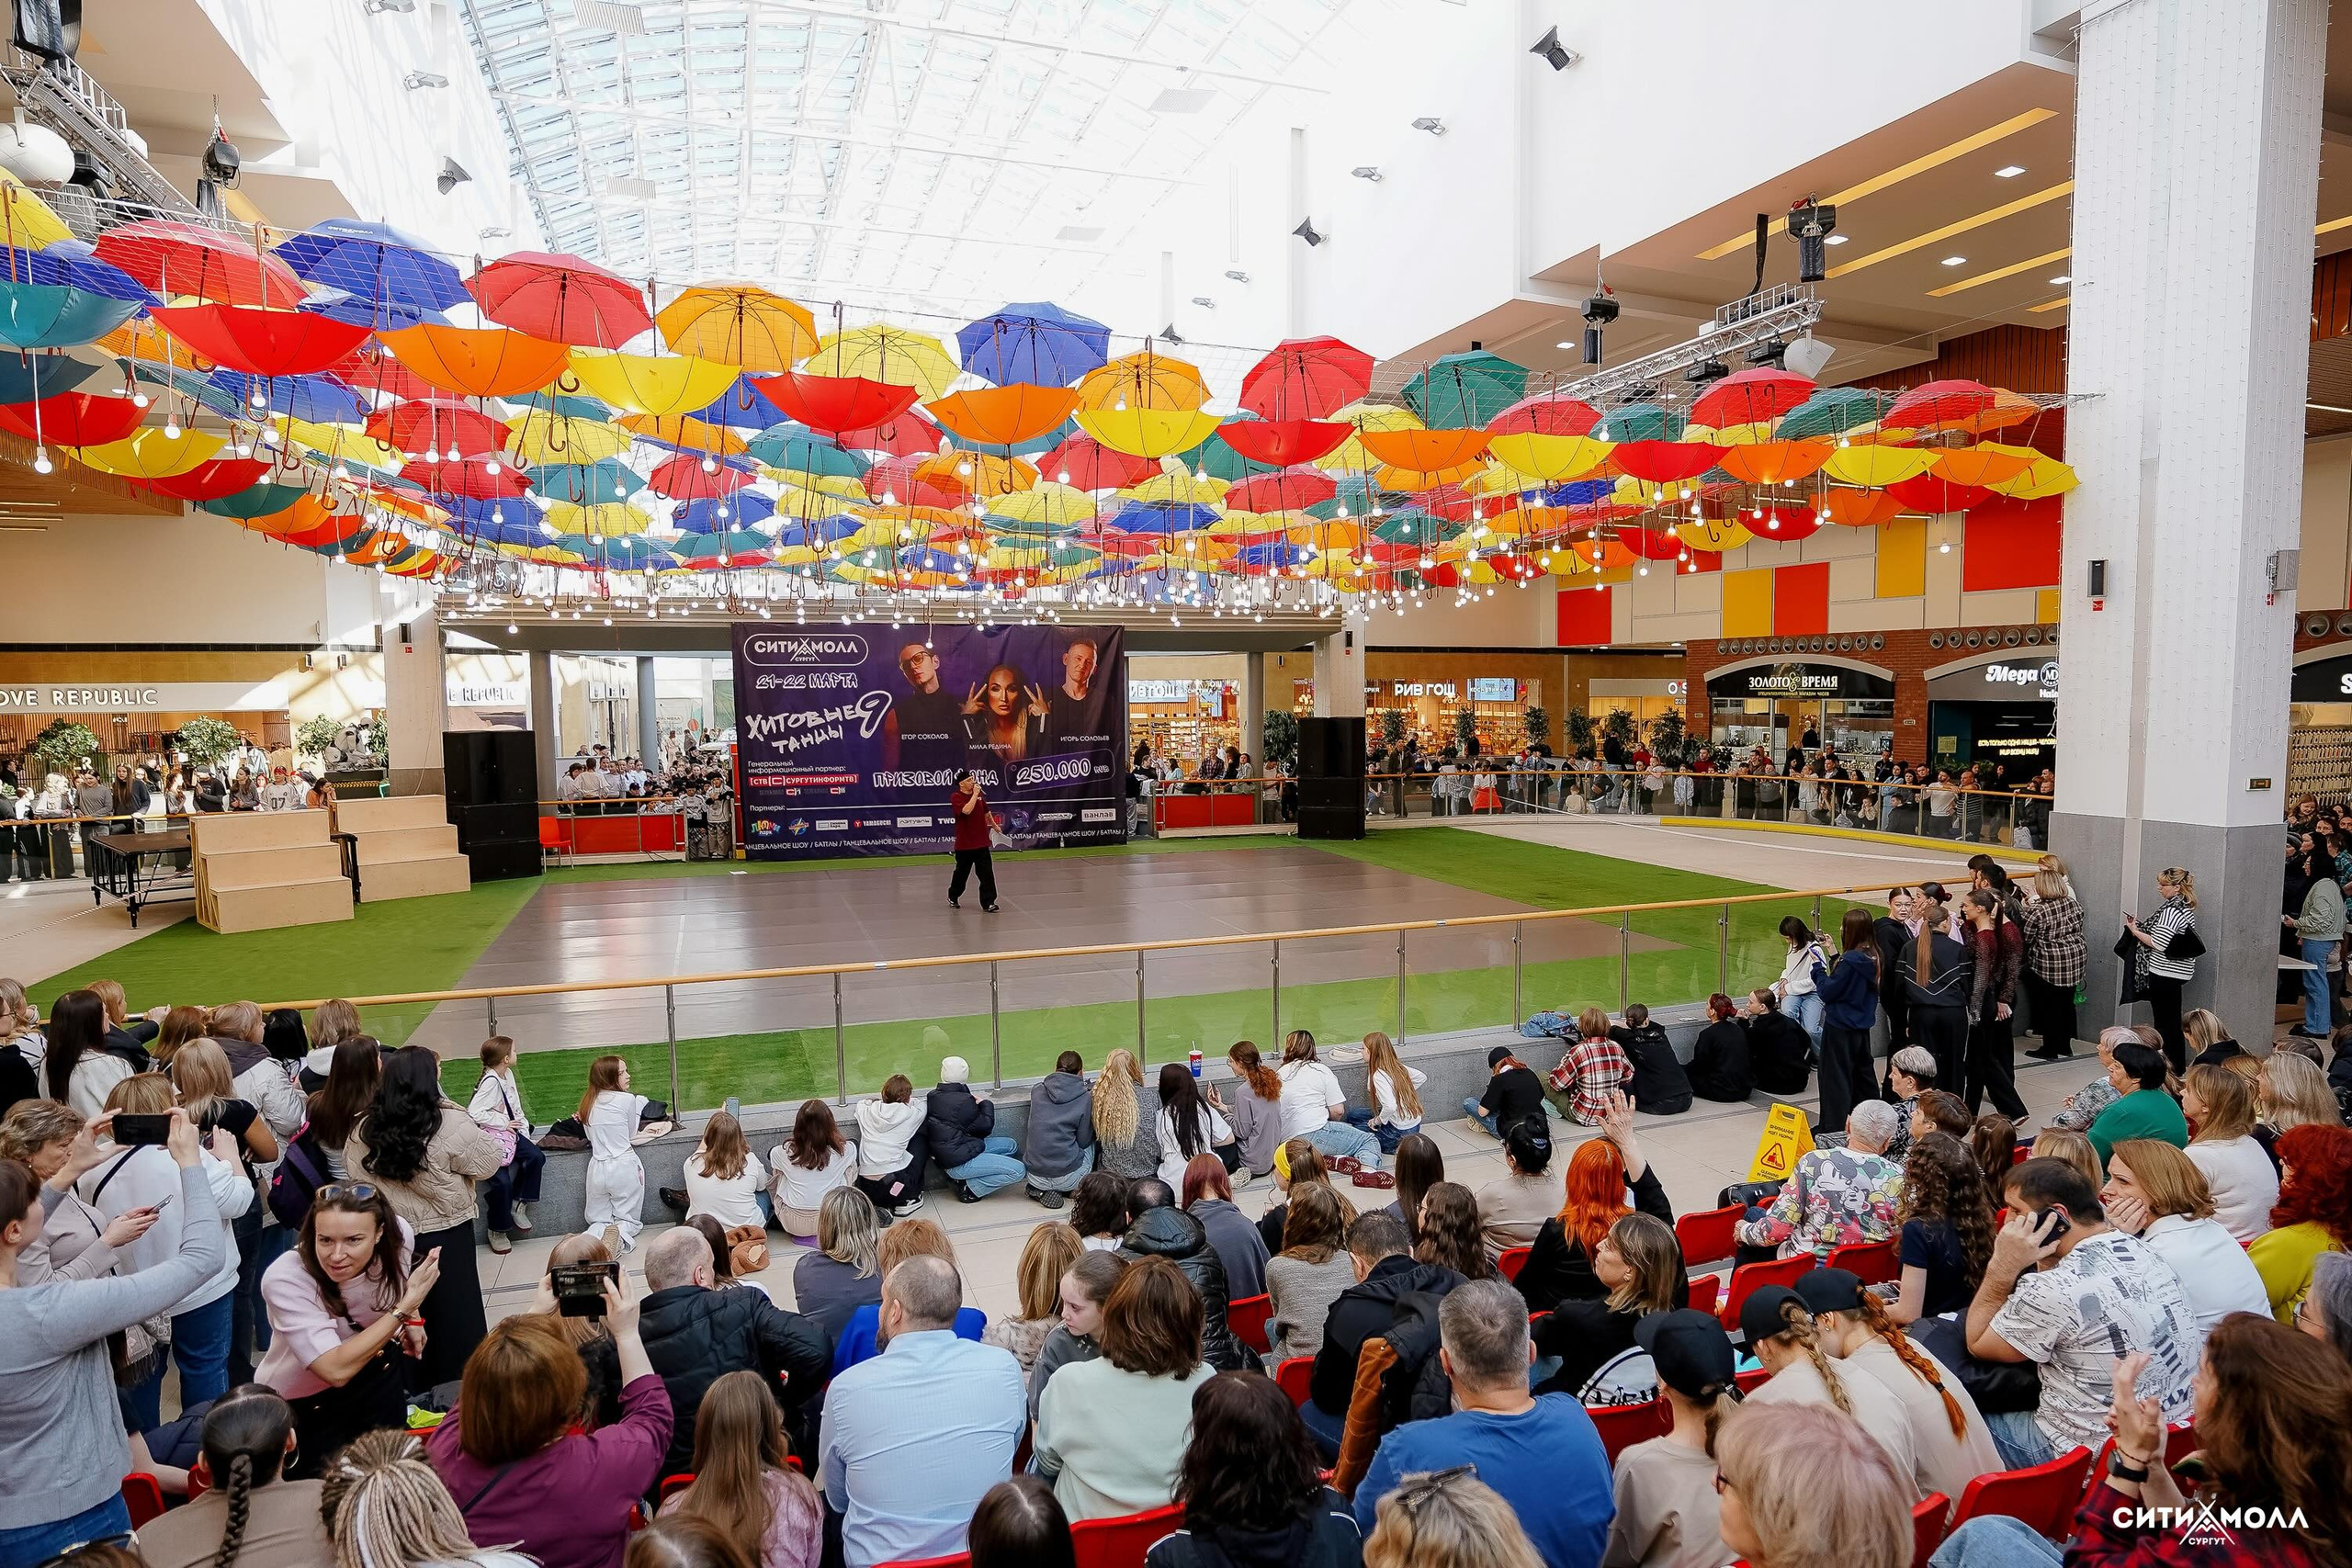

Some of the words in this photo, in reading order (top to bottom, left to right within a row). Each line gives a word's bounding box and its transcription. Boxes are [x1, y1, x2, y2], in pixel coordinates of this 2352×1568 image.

[754, 640, 797, 653] СИТИ
[811, 640, 858, 653] МОЛЛ
[755, 673, 807, 689] 21-22
[808, 672, 858, 689] МАРТА
[1748, 676, 1790, 688] ЗОЛОТО
[1802, 676, 1838, 688] ВРЕМЯ
[1985, 665, 2039, 685] Mega
[52, 688, 159, 706] REPUBLIC
[1395, 683, 1423, 696] РИВ
[1426, 683, 1455, 697] ГОШ
[745, 704, 857, 741] ХИТОВЫЕ
[771, 724, 843, 754] ТАНЦЫ
[748, 766, 814, 774] информационный
[1016, 758, 1091, 785] 250.000
[873, 768, 954, 788] ПРИЗОВОЙ
[955, 768, 999, 786] ОНД
[843, 838, 891, 847] ТАНЦЕВАЛЬНОЕ
[892, 837, 909, 845] ШОУ
[914, 836, 937, 844] БАТТЛЫ
[1036, 830, 1080, 840] ТАНЦЕВАЛЬНОЕ
[1101, 829, 1121, 837] БАТТЛЫ
[1770, 1123, 1794, 1135] ВНИМАНИЕ
[1760, 1168, 1780, 1179] CLEANING
